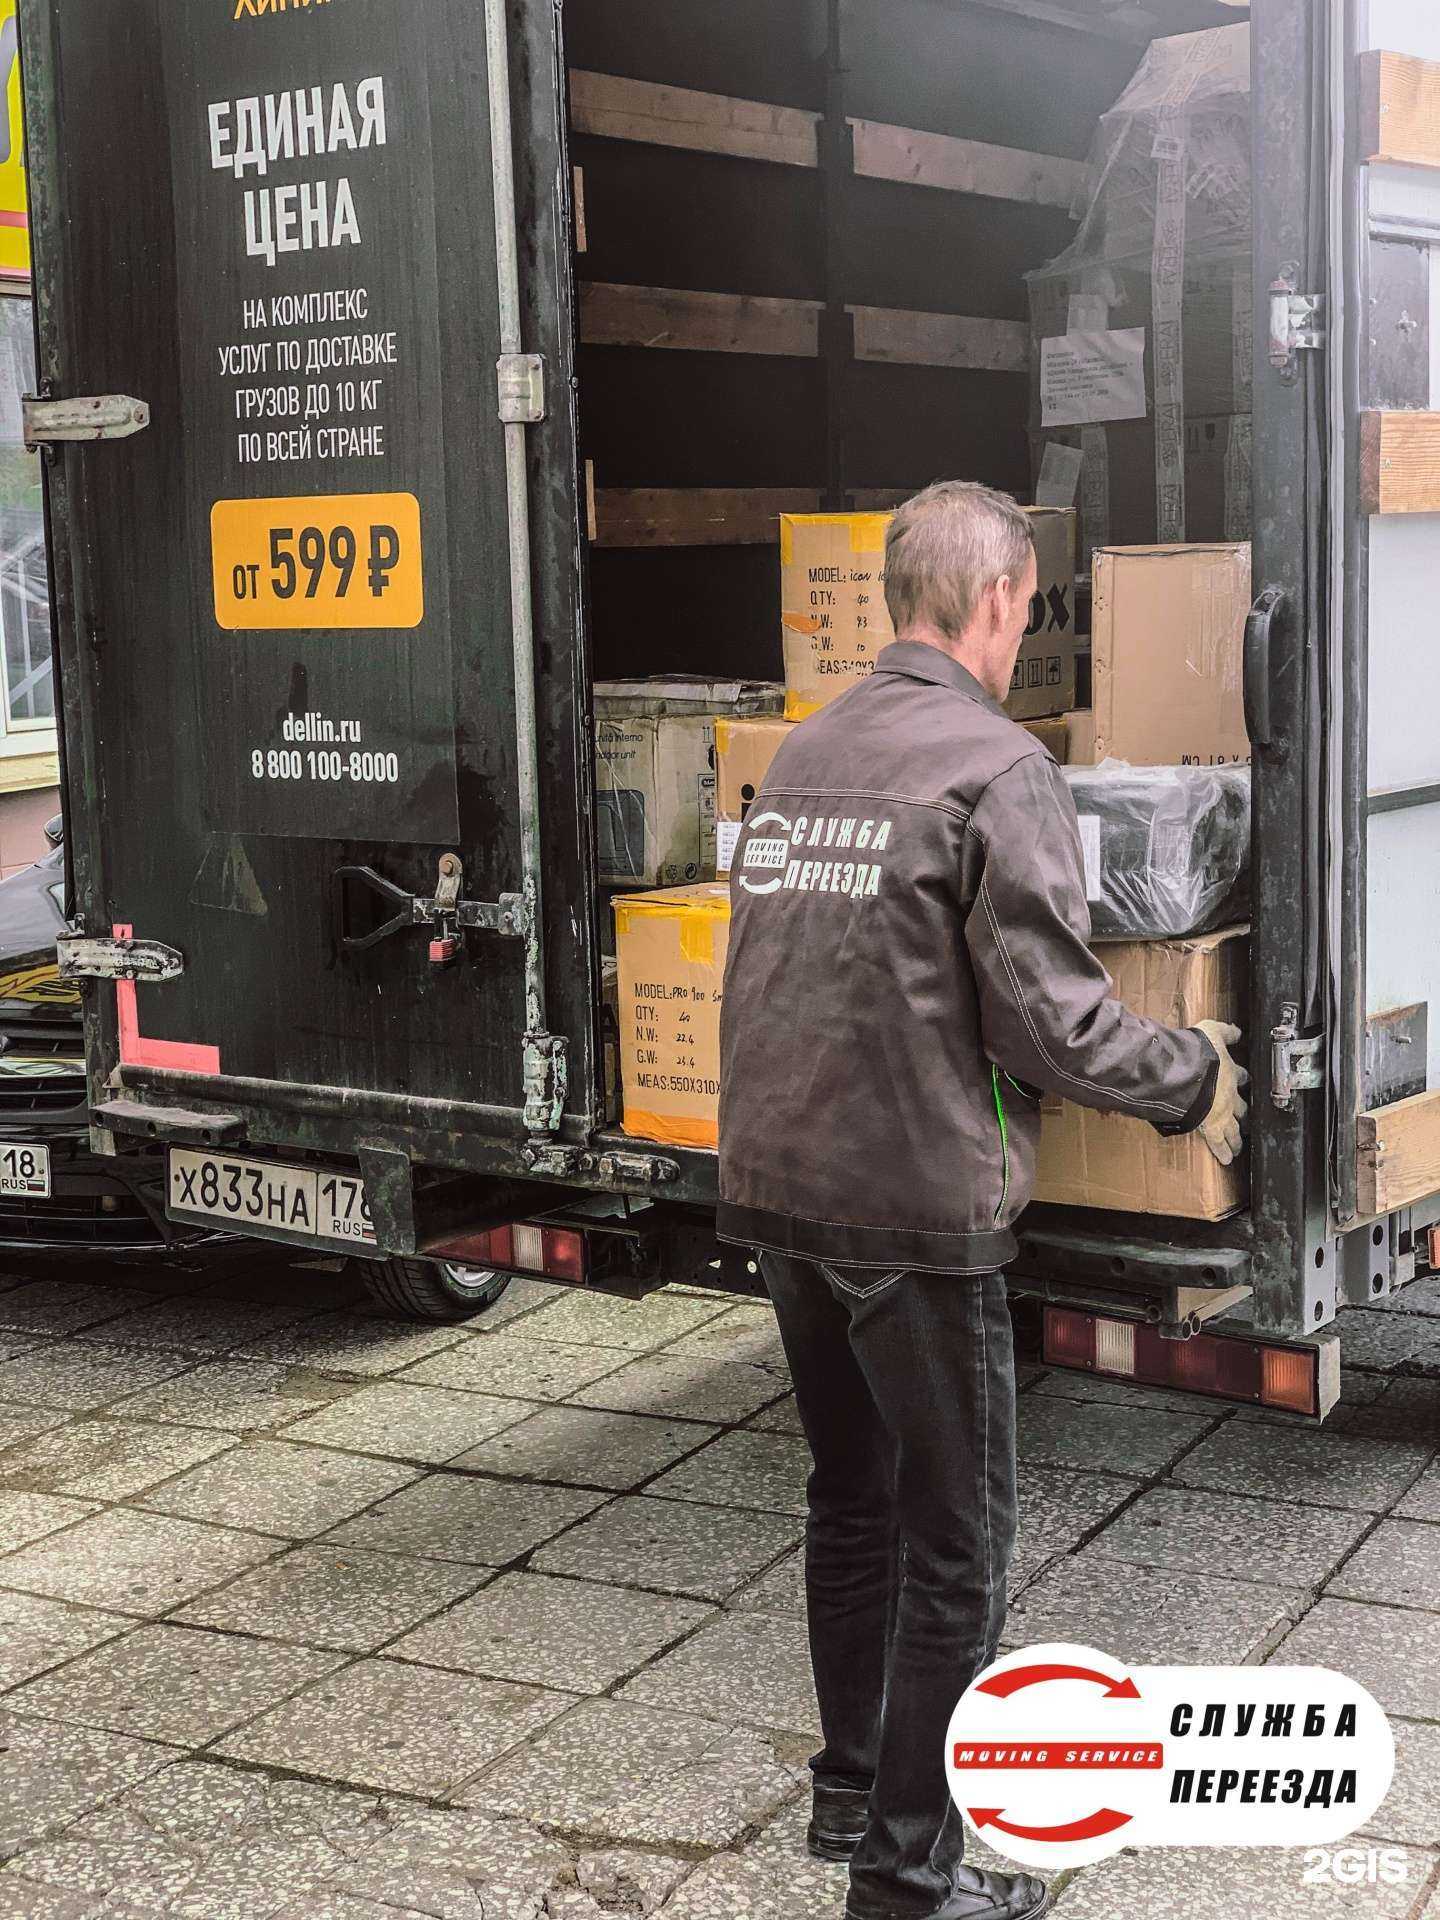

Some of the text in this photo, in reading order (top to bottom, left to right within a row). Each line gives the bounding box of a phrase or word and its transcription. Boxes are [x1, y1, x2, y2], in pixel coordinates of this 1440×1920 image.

[208, 76, 387, 178] ЕДИНАЯ
[244, 178, 362, 267] ЦЕНА
[243, 288, 368, 329] НА КОМПЛЕКС
[218, 332, 398, 376] УСЛУГ ПО ДОСТАВКЕ
[235, 379, 383, 419] ГРУЗОВ ДО 10 КГ
[238, 425, 385, 462] ПО ВСЕЙ СТРАНЕ
[808, 566, 846, 583] MODEL:
[283, 712, 361, 743] dellin.ru
[252, 750, 399, 782] 8 800 100-8000
[791, 816, 892, 850] СЛУЖБА
[783, 859, 882, 899] ПЕРЕЕЗДА
[634, 982, 672, 1000] MODEL:
[635, 1005, 659, 1022] QTY:
[636, 1026, 659, 1042] N.W:
[637, 1049, 658, 1064] G.W:
[3, 1149, 35, 1178] 18
[1, 1179, 26, 1190] RUS
[333, 1220, 361, 1236] RUS
